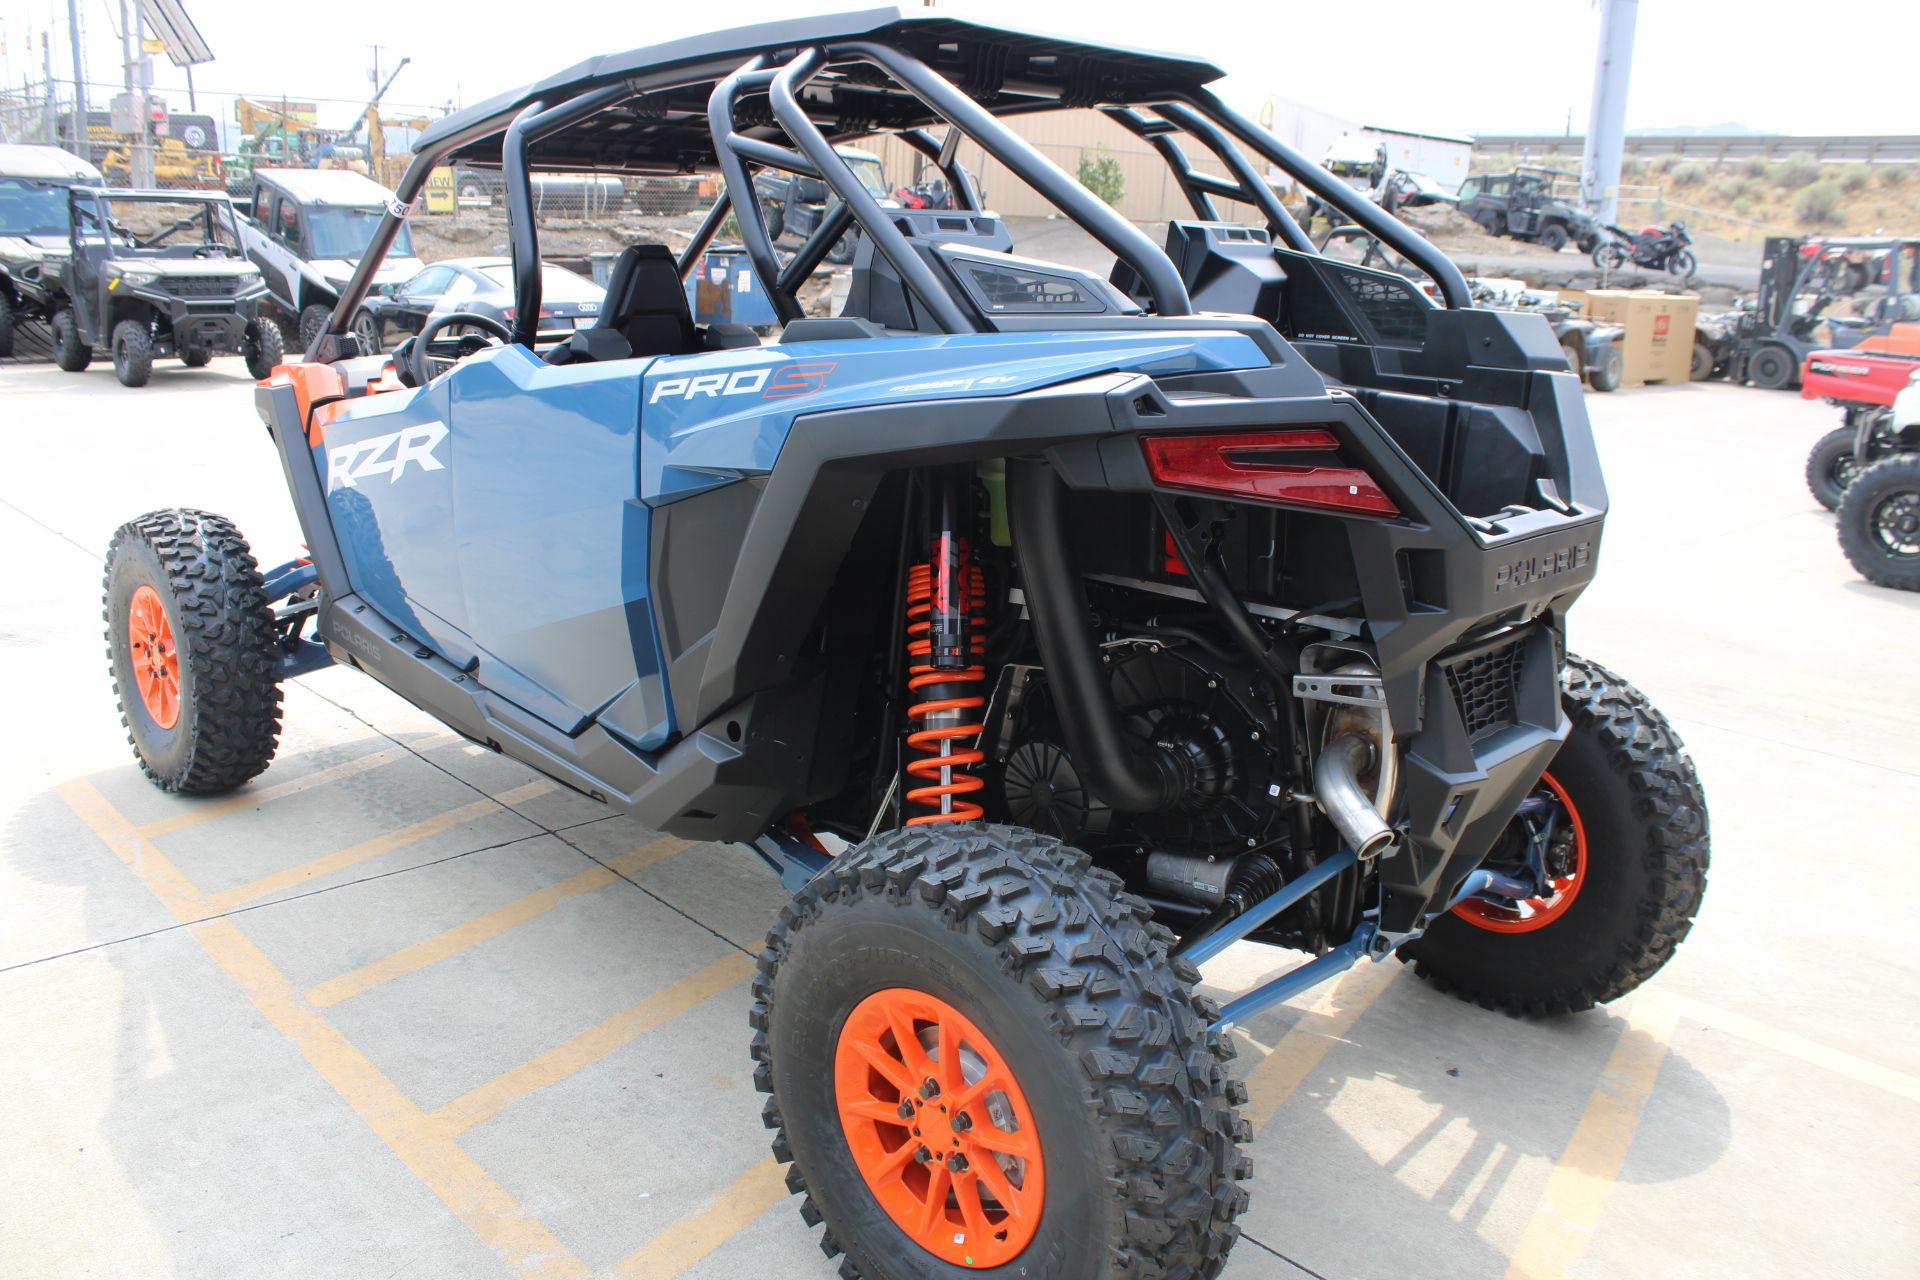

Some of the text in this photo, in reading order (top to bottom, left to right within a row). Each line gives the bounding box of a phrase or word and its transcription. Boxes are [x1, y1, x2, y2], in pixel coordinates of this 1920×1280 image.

[649, 362, 838, 404] PRO S
[327, 420, 450, 497] RZR
[1495, 542, 1591, 592] POLARIS
[332, 619, 382, 661] POLARIS
